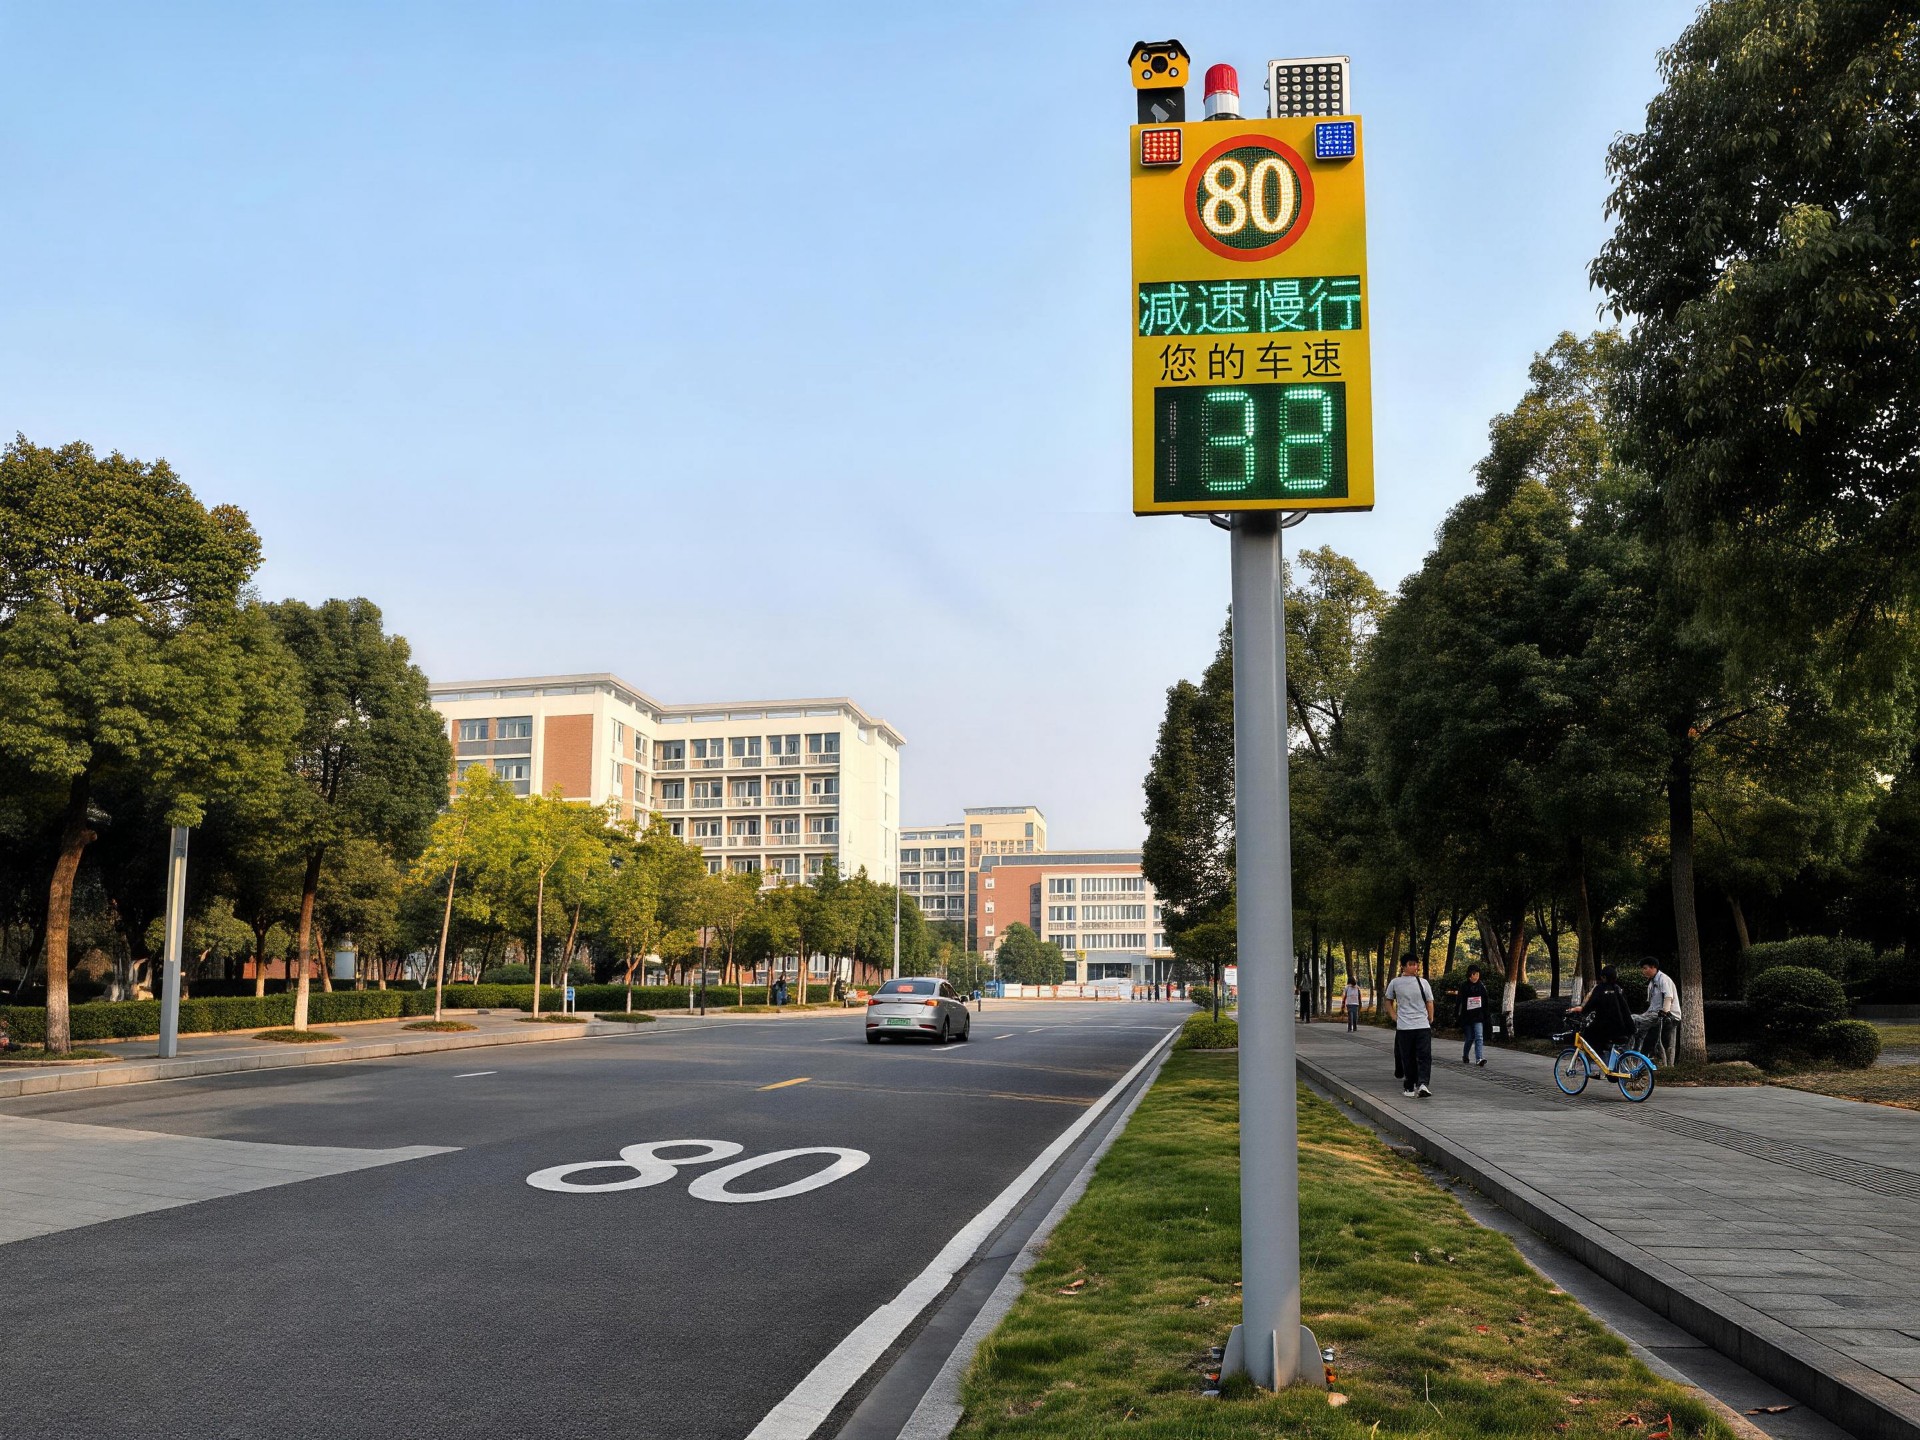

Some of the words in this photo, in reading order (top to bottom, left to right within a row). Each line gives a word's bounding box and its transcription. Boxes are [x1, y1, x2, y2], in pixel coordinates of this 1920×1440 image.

[1202, 157, 1295, 235] 80
[1139, 278, 1361, 336] 减速慢行
[1159, 338, 1343, 382] 您的车速
[526, 1139, 870, 1203] 80
